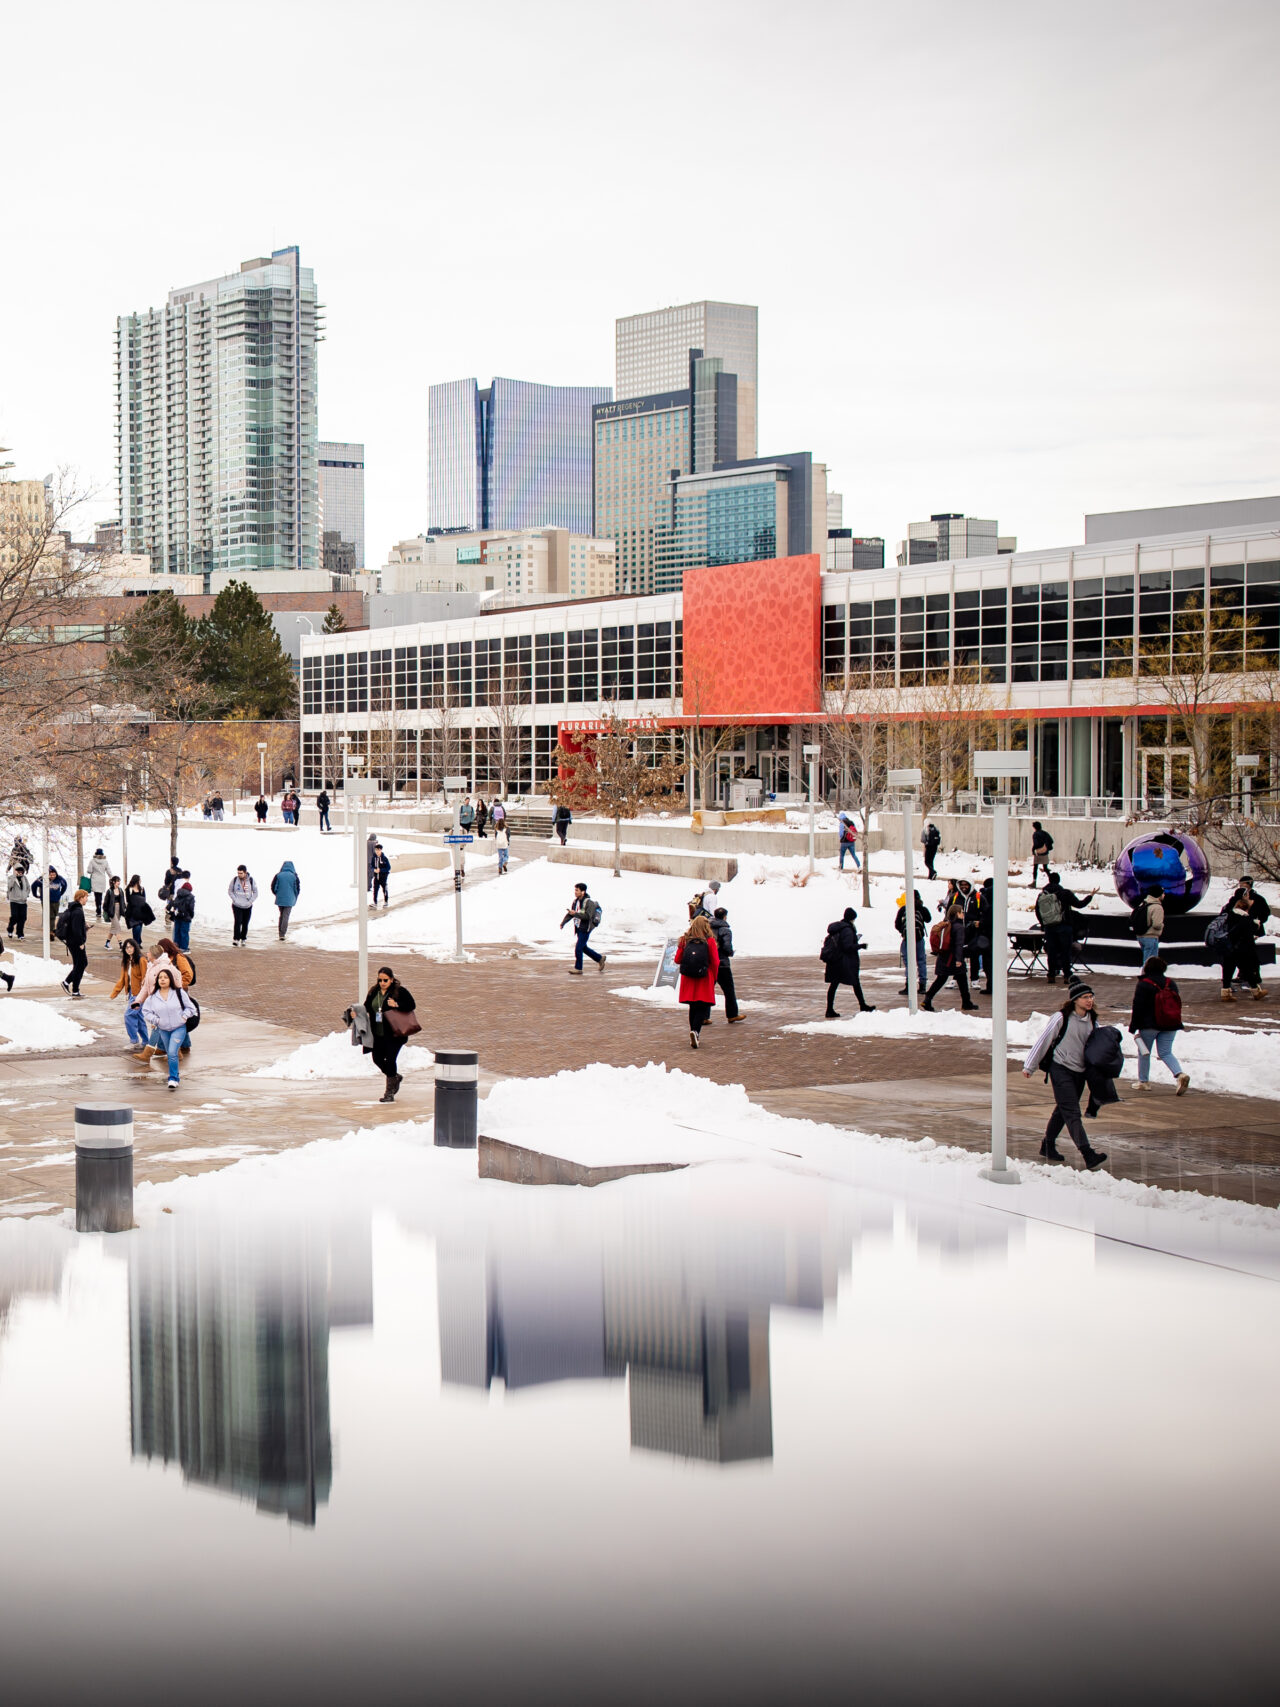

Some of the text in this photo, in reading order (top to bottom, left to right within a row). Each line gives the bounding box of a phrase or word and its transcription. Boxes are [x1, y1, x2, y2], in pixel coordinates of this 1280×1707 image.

[596, 401, 645, 415] HYATT REGENCY
[560, 721, 607, 730] AURARIA
